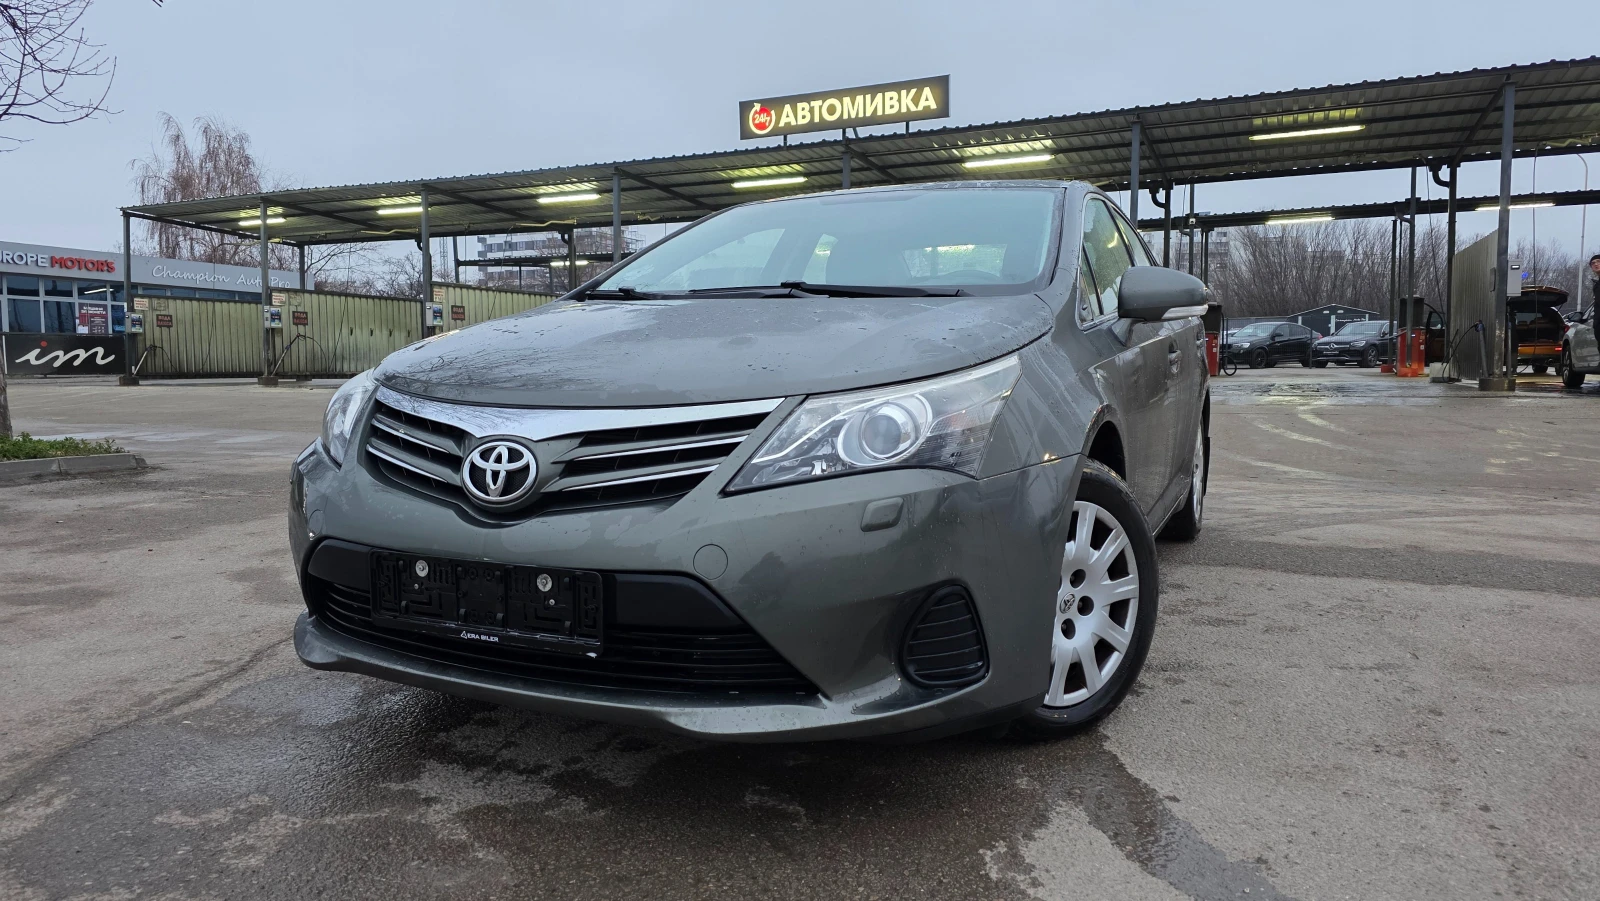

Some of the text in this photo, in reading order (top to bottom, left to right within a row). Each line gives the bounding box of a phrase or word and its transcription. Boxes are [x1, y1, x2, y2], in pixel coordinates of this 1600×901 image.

[779, 86, 937, 127] АВТОМИВКА
[0, 250, 49, 267] ROPE
[152, 265, 291, 289] Champion Aut Pro
